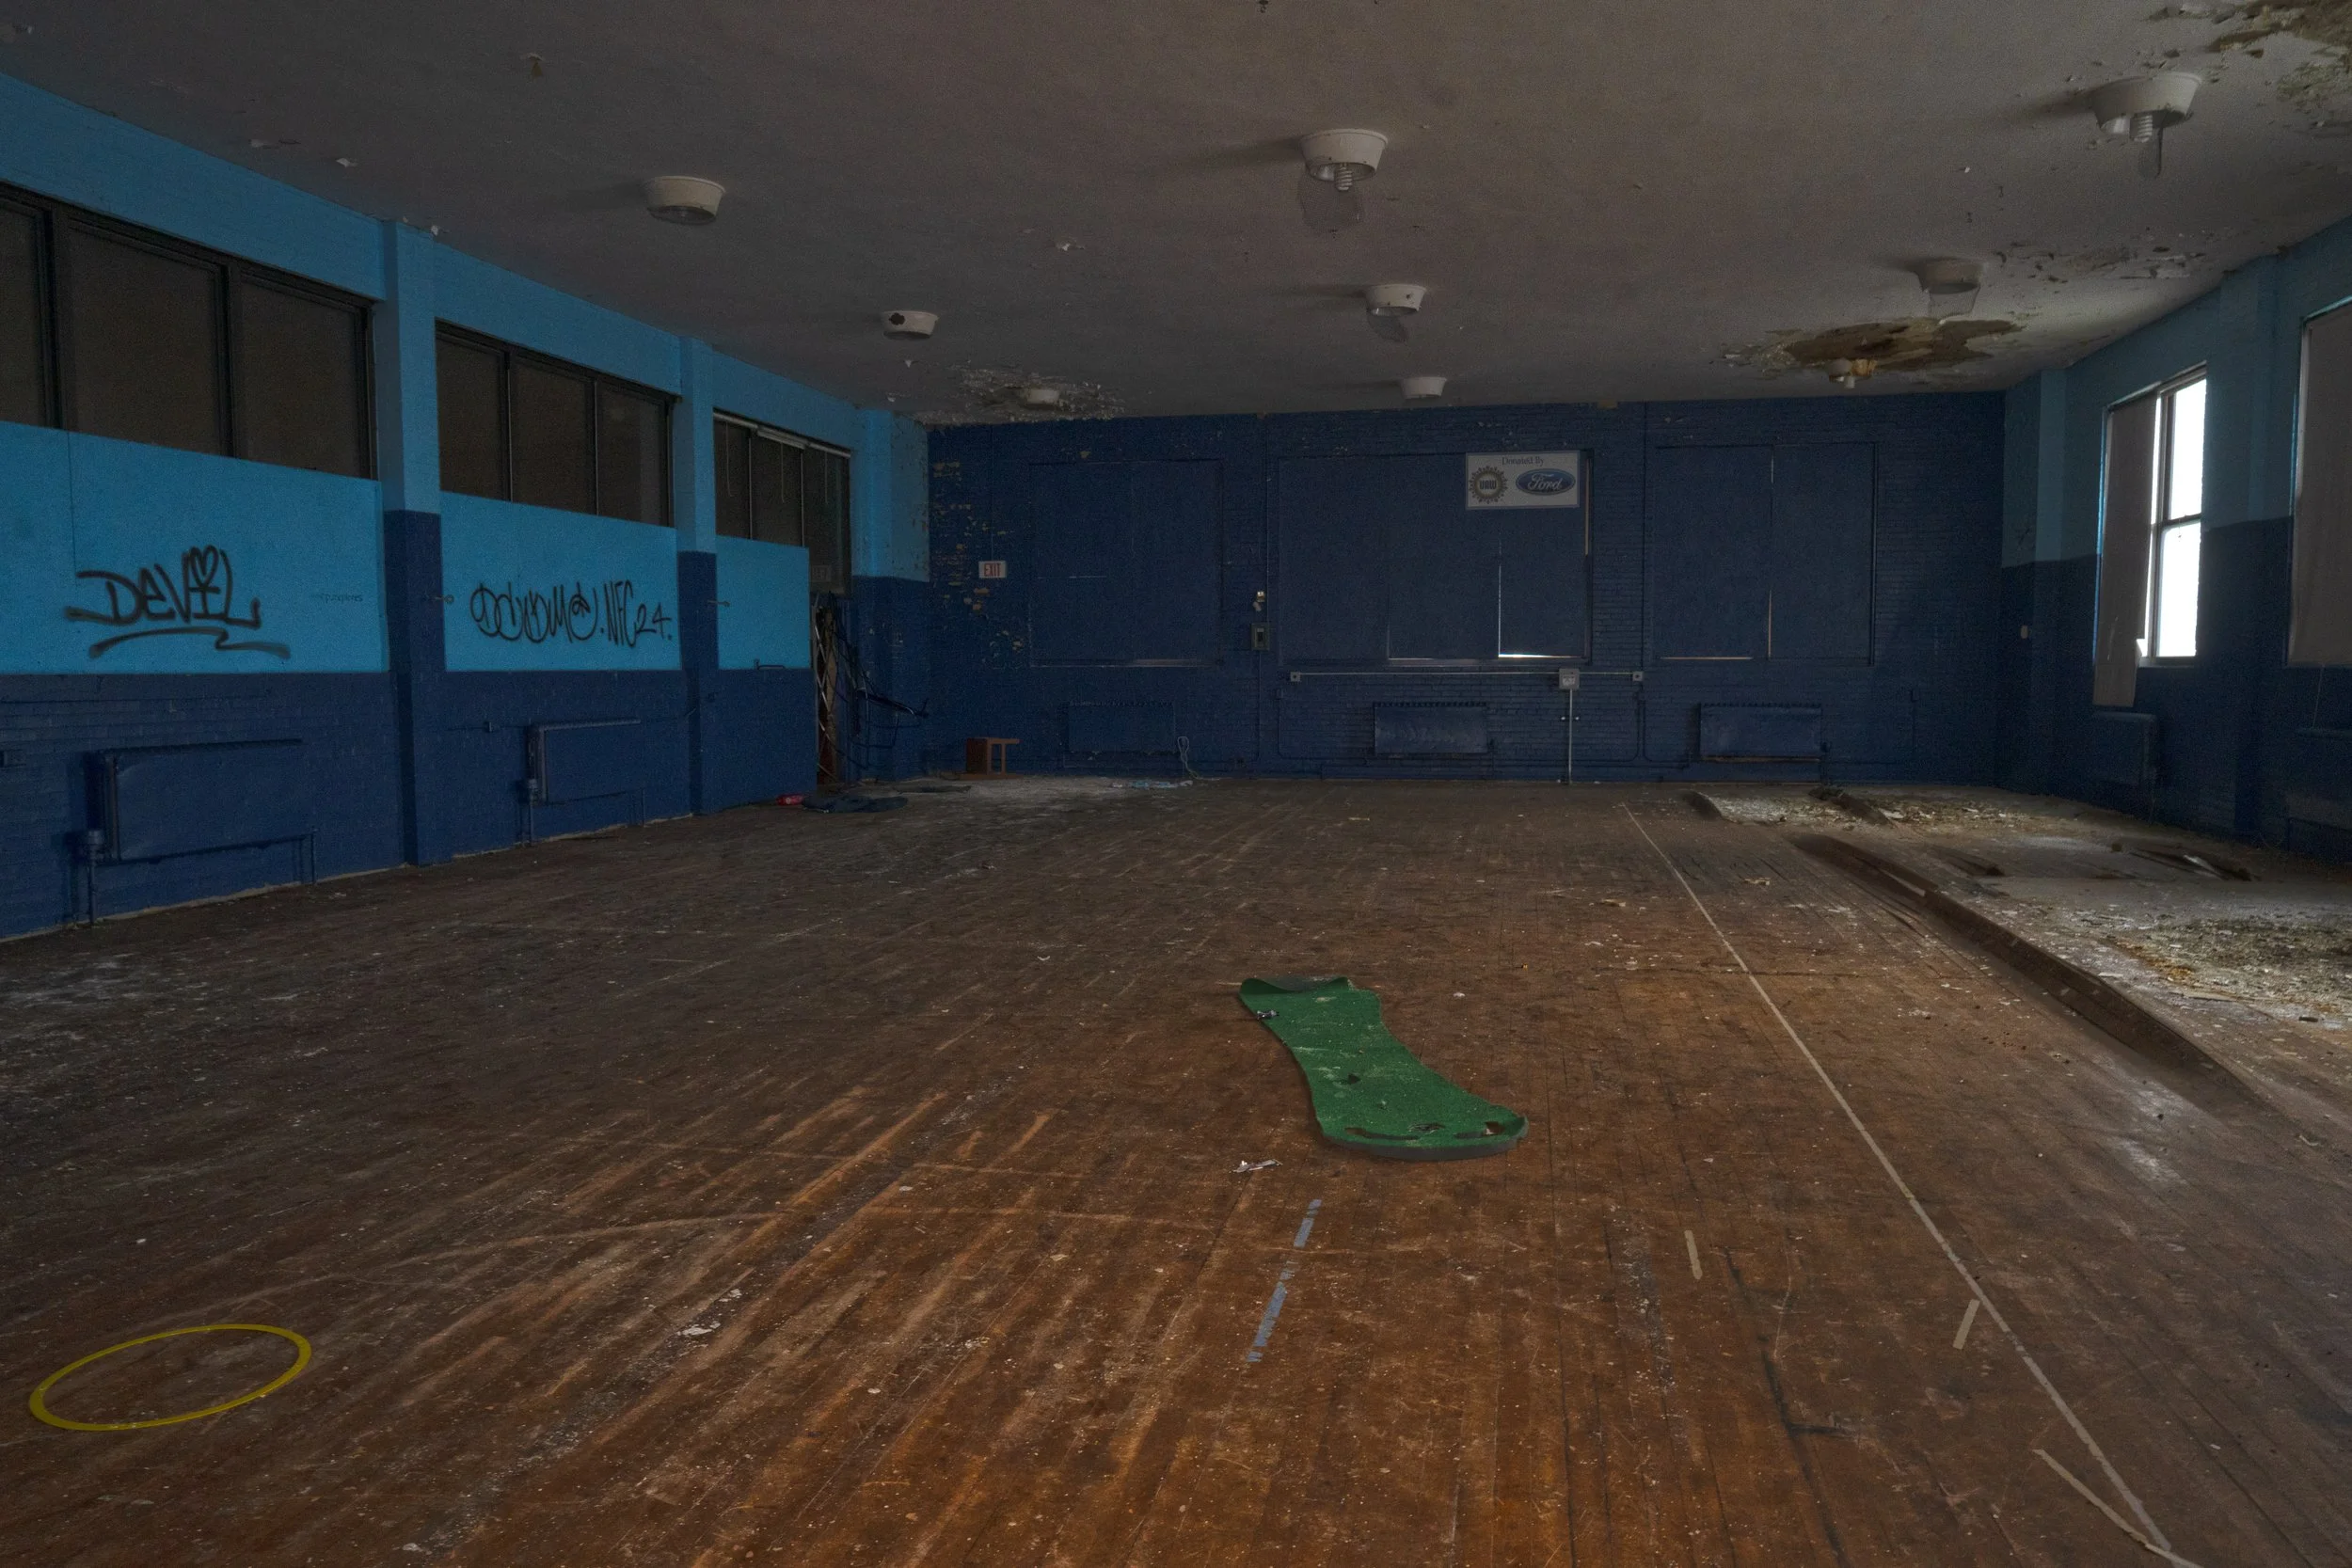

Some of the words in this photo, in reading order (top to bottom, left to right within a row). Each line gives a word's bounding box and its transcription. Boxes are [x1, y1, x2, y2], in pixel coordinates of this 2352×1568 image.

[1502, 456, 1533, 466] Donated
[1527, 473, 1563, 490] Ford
[984, 563, 1001, 577] EXIT
